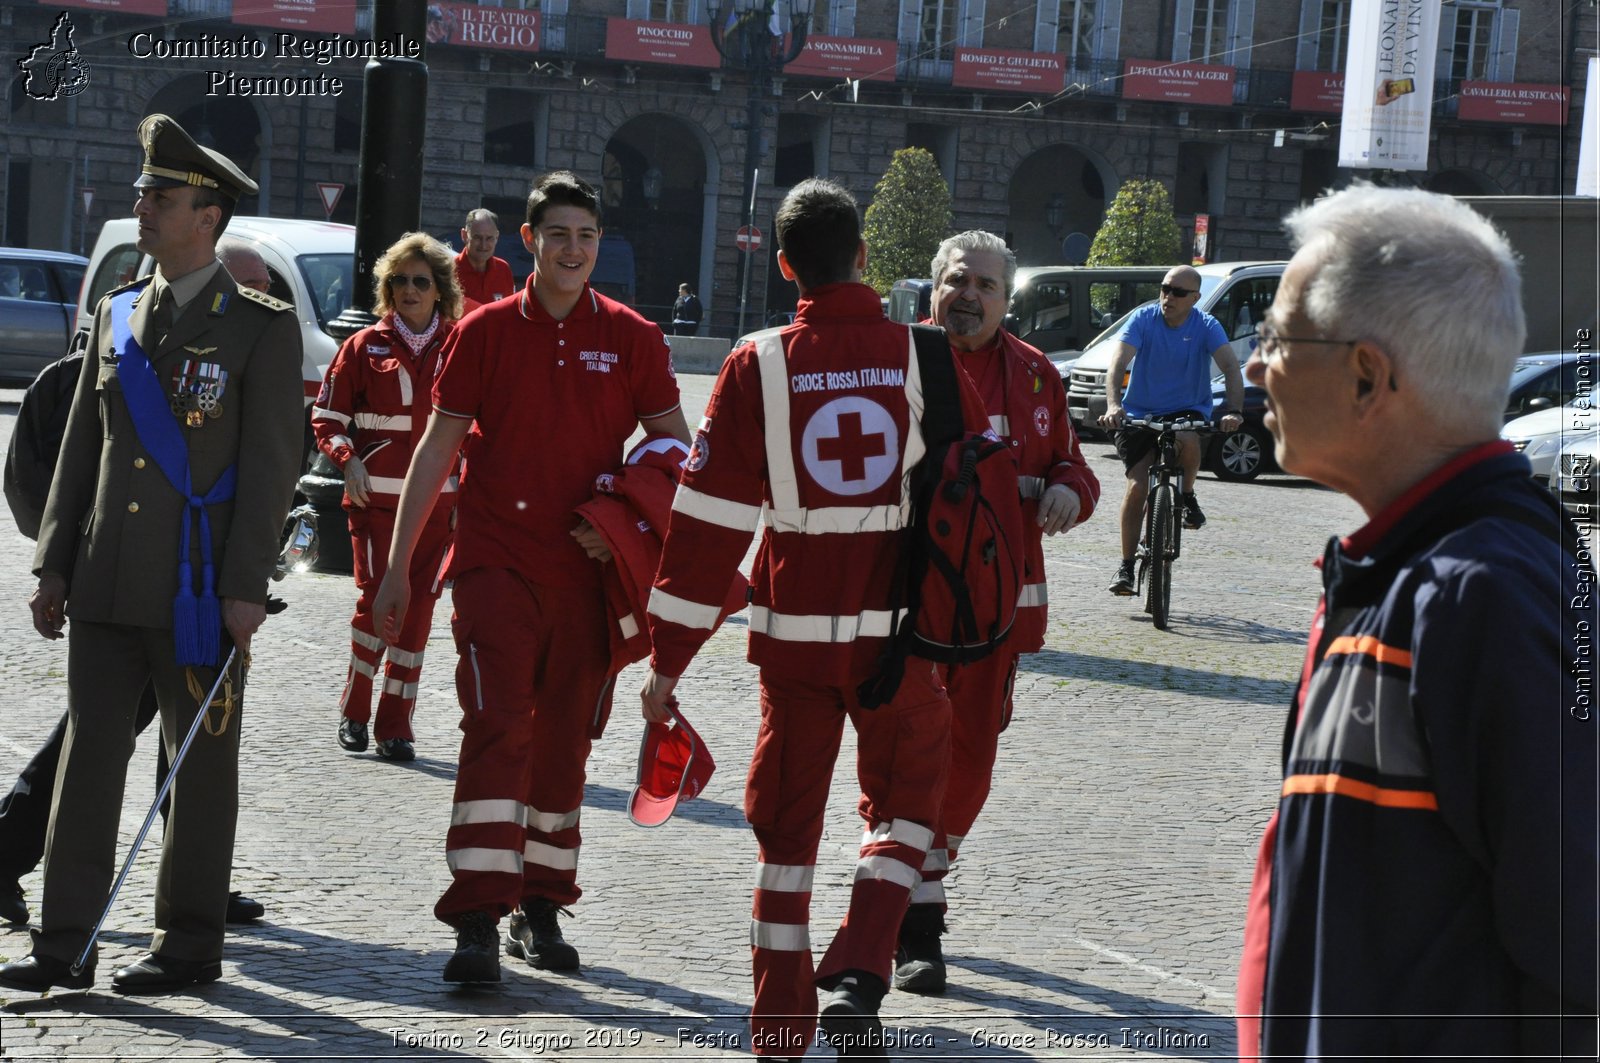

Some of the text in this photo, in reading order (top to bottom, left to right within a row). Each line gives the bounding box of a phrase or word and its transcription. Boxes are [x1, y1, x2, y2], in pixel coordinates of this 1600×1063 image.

[462, 8, 536, 26] IL TEATRO
[461, 22, 535, 47] REGIO
[636, 26, 694, 40] PINOCCHIO
[814, 41, 883, 56] SONNAMBULA
[960, 53, 1059, 69] ROMEO E GIULIETTA
[1403, 49, 1418, 75] DA
[1130, 66, 1230, 82] L'ITALIANA IN ALGERI
[1324, 78, 1337, 88] LA
[1462, 87, 1567, 102] CAVALLERIA RUSTICANA
[579, 350, 618, 364] CROCE ROSSA
[586, 360, 610, 373] ITALIANA
[792, 367, 905, 394] CROCE ROSSA ITALIANA
